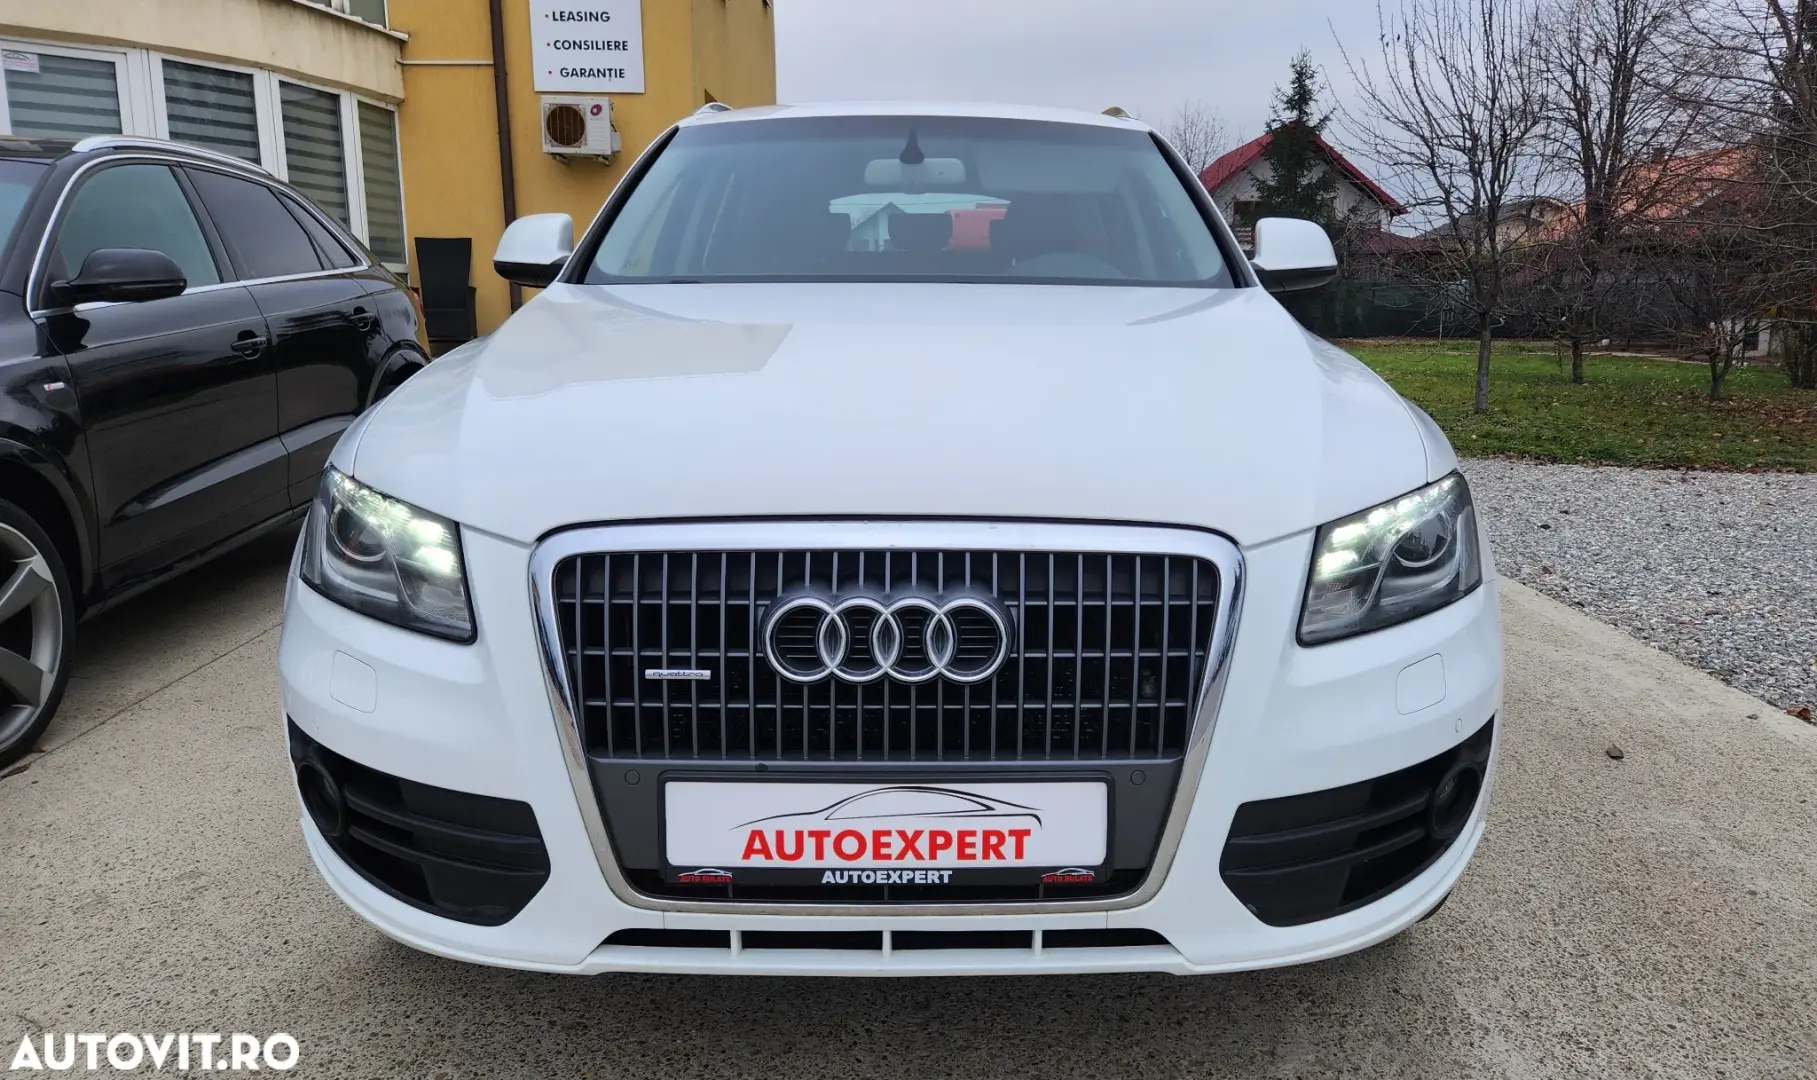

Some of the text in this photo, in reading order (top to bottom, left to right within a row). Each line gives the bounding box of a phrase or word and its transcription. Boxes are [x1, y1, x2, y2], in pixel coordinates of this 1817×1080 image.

[552, 11, 611, 22] LEASING
[553, 40, 628, 51] CONSILIERE
[560, 67, 625, 81] GARANȚIE
[742, 829, 1031, 861] AUTOEXPERT
[821, 870, 952, 884] AUTOEXPERT
